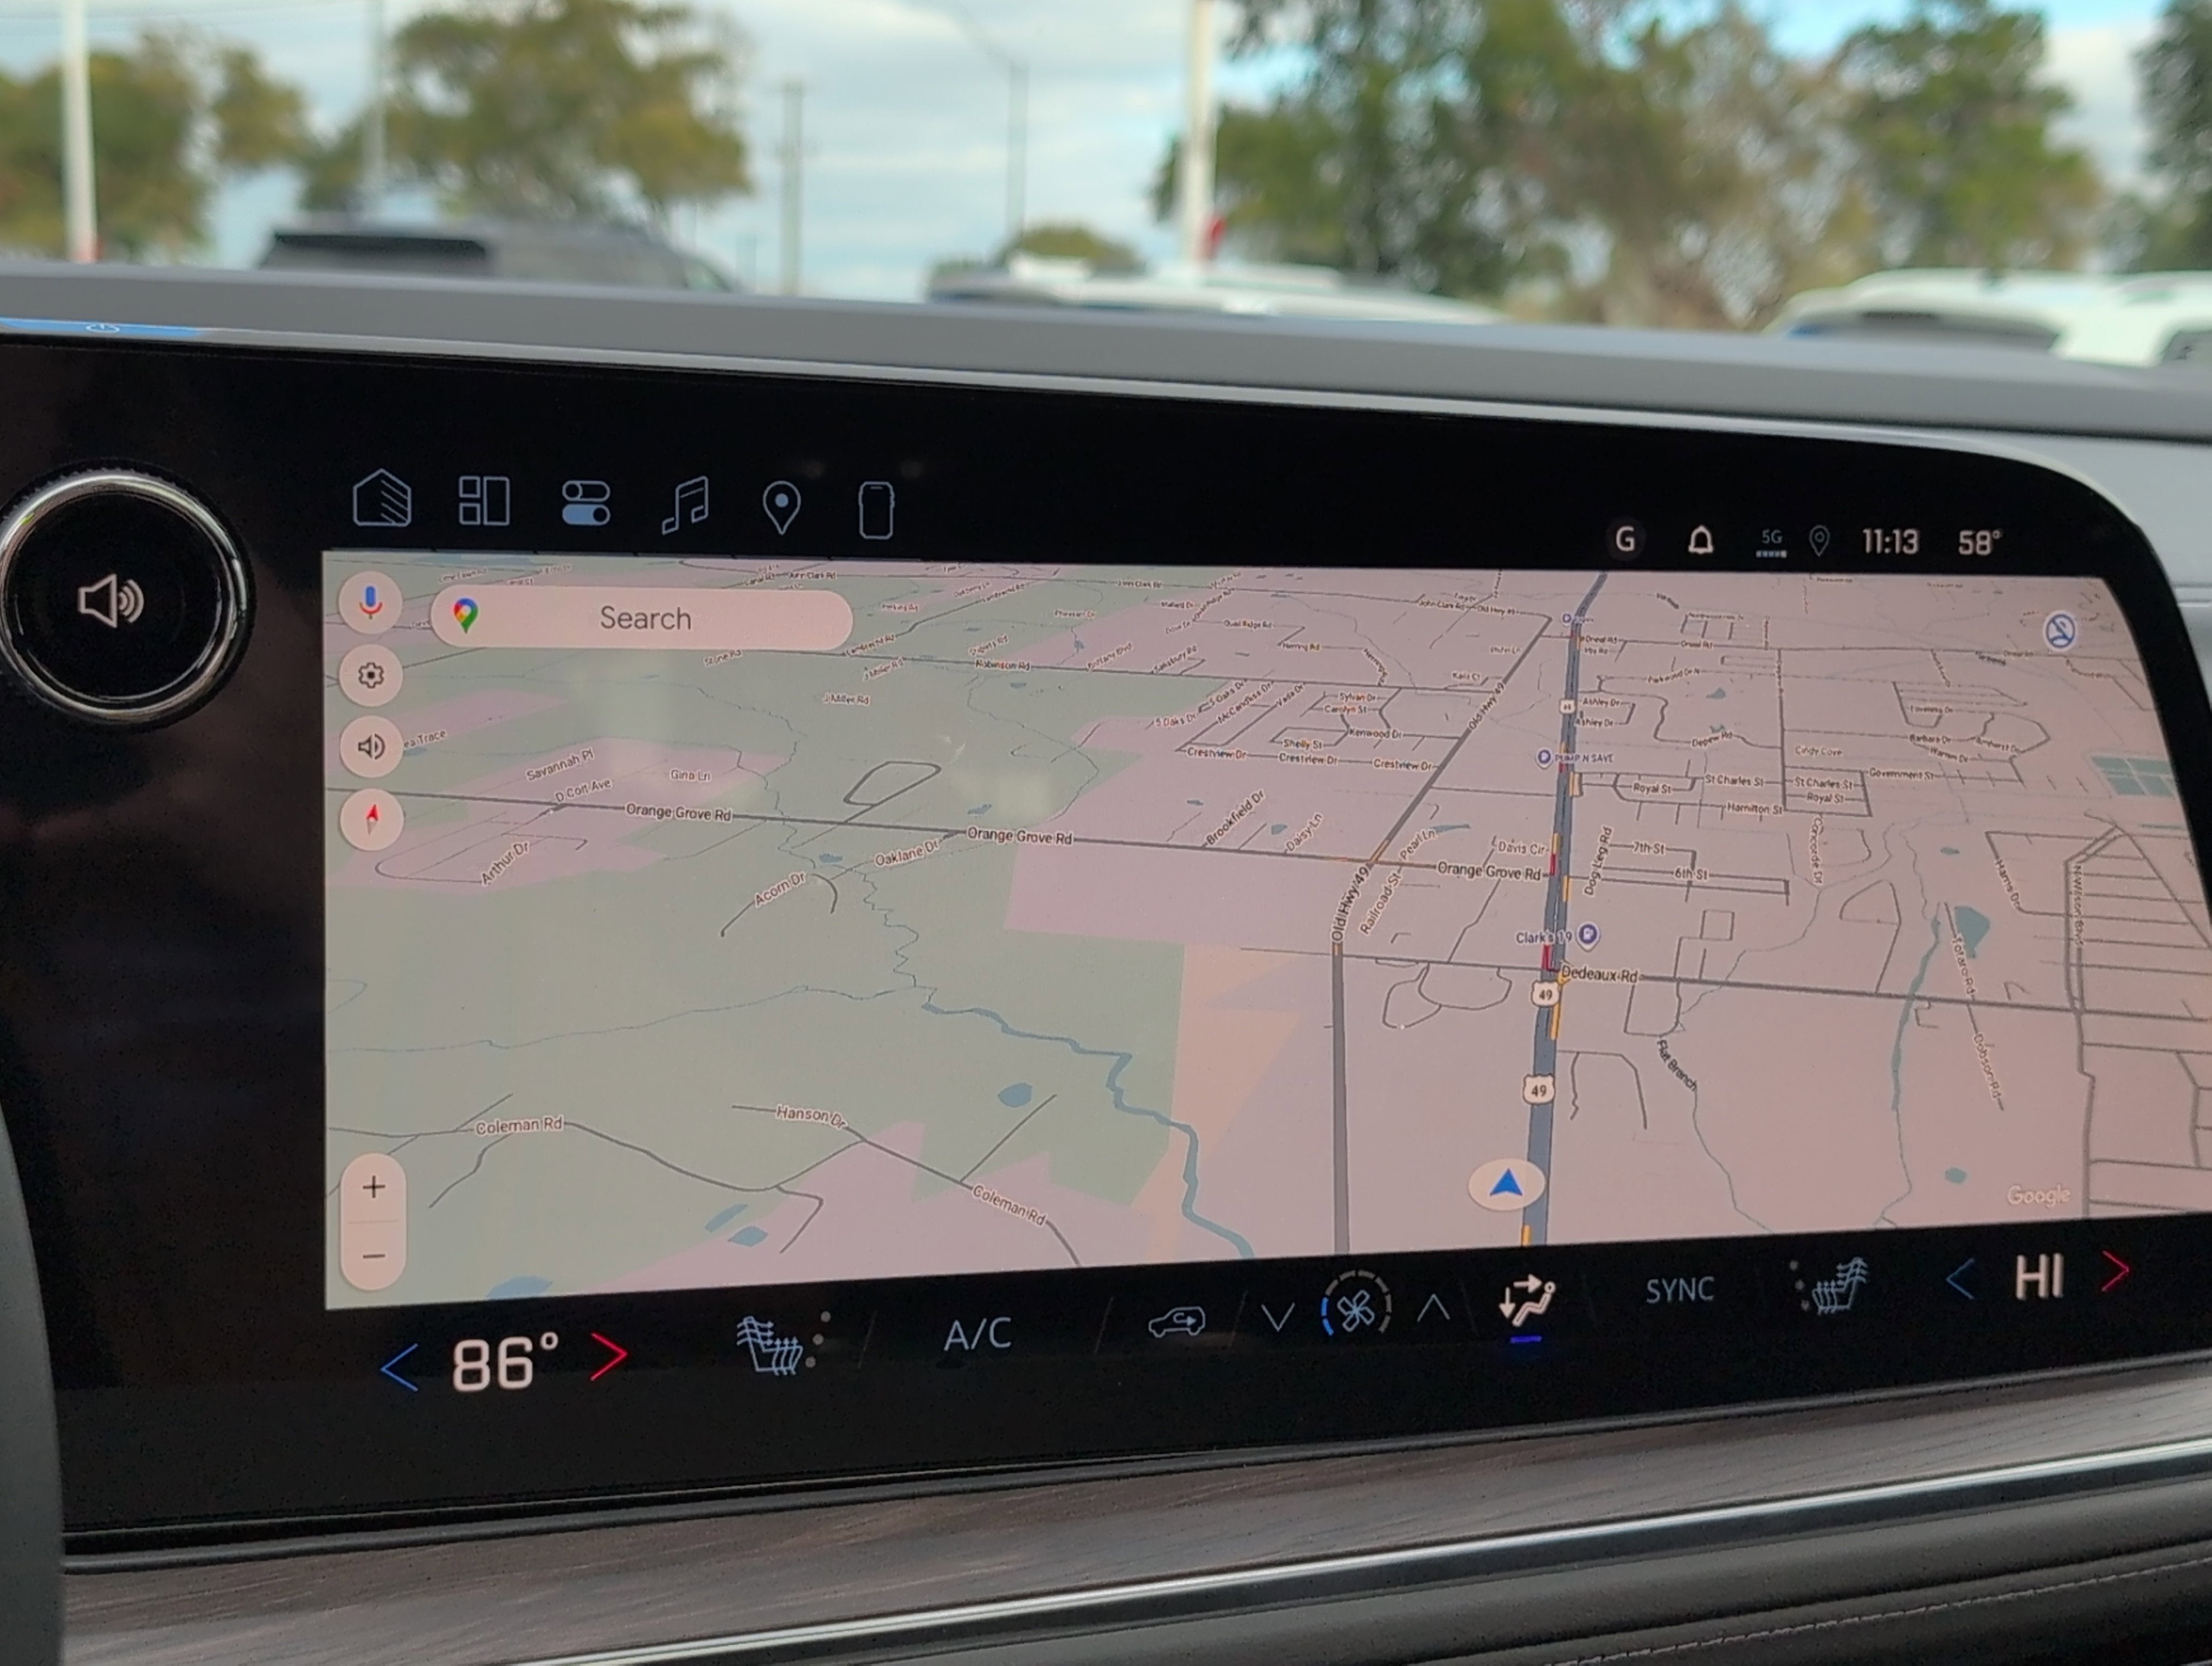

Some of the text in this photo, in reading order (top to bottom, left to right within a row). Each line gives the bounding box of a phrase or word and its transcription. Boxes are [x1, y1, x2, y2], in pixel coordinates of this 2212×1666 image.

[1762, 530, 1783, 543] 5G
[1863, 528, 1919, 555] 11:13
[1959, 529, 2003, 555] 58°
[600, 605, 692, 630] Search
[417, 729, 447, 745] Trace
[1349, 729, 1390, 739] Kenwood
[1187, 747, 1246, 759] Crestview Dr
[1278, 753, 1339, 765] Crestview Dr
[1794, 746, 1843, 757] Cindy Cove
[526, 753, 581, 781] Savannah
[670, 769, 695, 780] Gina
[1373, 759, 1433, 771] Crestview Dr
[1869, 767, 1924, 780] Government
[591, 779, 611, 791] Ave
[1633, 782, 1672, 795] Royal St
[1705, 774, 1715, 784] St
[1716, 776, 1752, 786] Charles
[1805, 778, 1841, 789] Charles
[1806, 792, 1832, 804] Royal
[626, 803, 732, 823] Orange Grove Rd
[1206, 789, 1265, 845] Brookfield Dr
[1727, 802, 1783, 815] Hamilton St
[967, 826, 1073, 845] Orange Grove Rd
[1285, 813, 1323, 852] Daisy Ln
[874, 840, 940, 867] Oaklane Dr
[1399, 833, 1424, 861] Pearl
[1498, 840, 1527, 855] Davis
[1632, 842, 1664, 855] 7th St
[481, 841, 529, 885] Arthur Dr
[1437, 861, 1541, 881] Orange Grove Rd
[1584, 870, 1602, 896] Dog
[1600, 826, 1612, 845] Rd
[1674, 868, 1707, 880] 6th St
[755, 872, 806, 906] Acorn Dr
[1332, 864, 1371, 943] Old Hwy 49
[1360, 869, 1401, 935] Railroad St
[1516, 931, 1554, 944] Clark's
[1561, 965, 1638, 983] Dedeaux Rd
[1539, 990, 1553, 1001] 49
[1667, 1059, 1697, 1092] Branch
[1531, 1085, 1547, 1097] 49
[475, 1116, 563, 1136] Coleman Rd
[776, 1105, 846, 1129] Hanson Dr
[972, 1183, 1046, 1227] Coleman Rd
[2007, 1183, 2072, 1210] Google
[2015, 1252, 2063, 1300] HI
[1646, 1275, 1715, 1303] SYNC
[943, 1316, 1011, 1352] A/C
[453, 1331, 558, 1392] 86°
